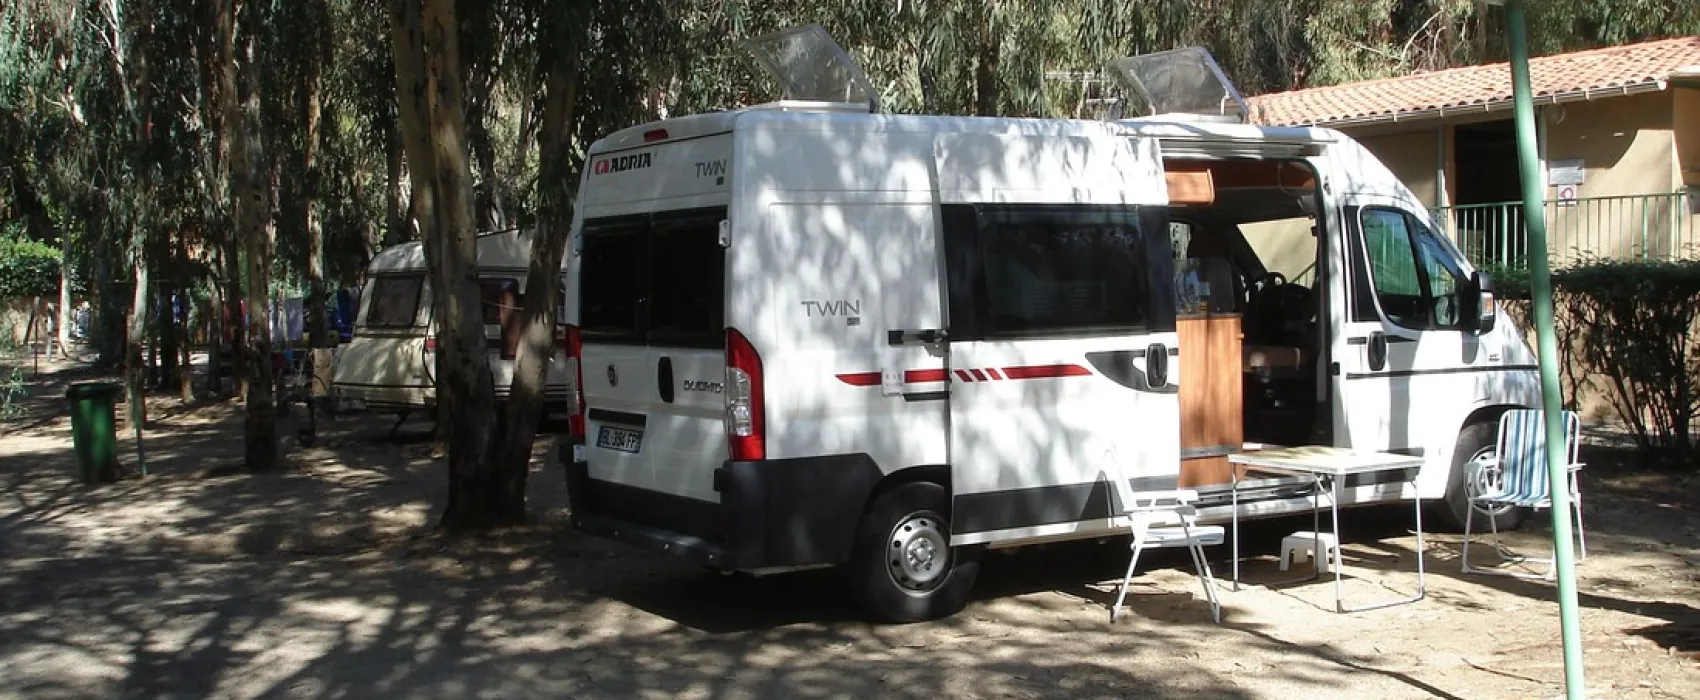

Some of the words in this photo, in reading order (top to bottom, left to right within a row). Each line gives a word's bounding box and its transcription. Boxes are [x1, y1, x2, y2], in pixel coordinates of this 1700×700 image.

[610, 152, 652, 173] ADRIA
[694, 159, 727, 178] TWIN
[801, 300, 860, 317] TWIN
